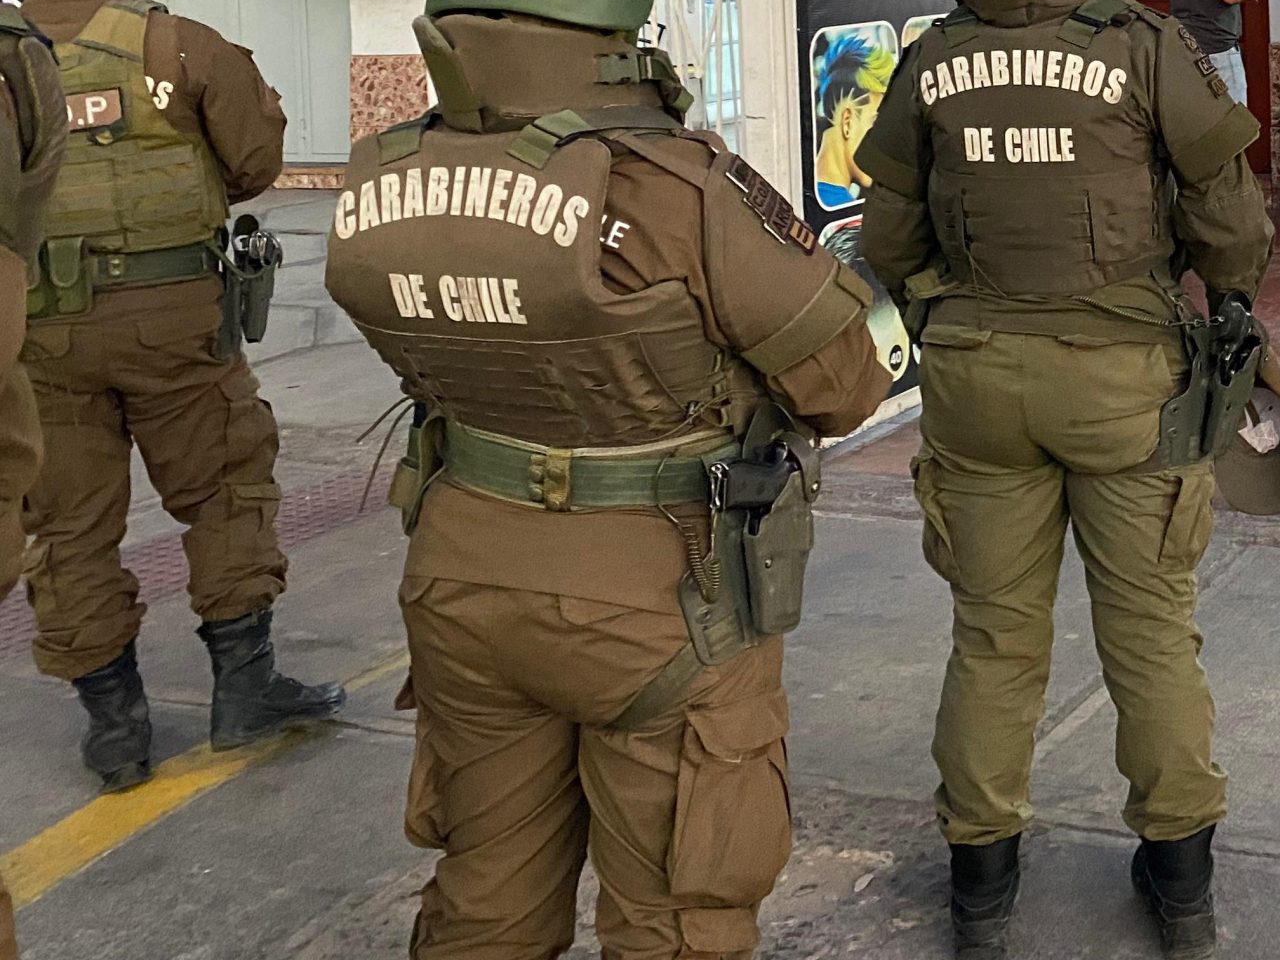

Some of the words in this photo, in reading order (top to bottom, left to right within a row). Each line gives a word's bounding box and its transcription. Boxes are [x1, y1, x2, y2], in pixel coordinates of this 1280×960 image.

[919, 49, 1127, 106] CARABINEROS
[963, 127, 995, 162] DE
[1004, 127, 1075, 163] CHILE
[334, 166, 590, 248] CARABINEROS
[388, 273, 435, 319] DE
[439, 276, 528, 325] CHILE
